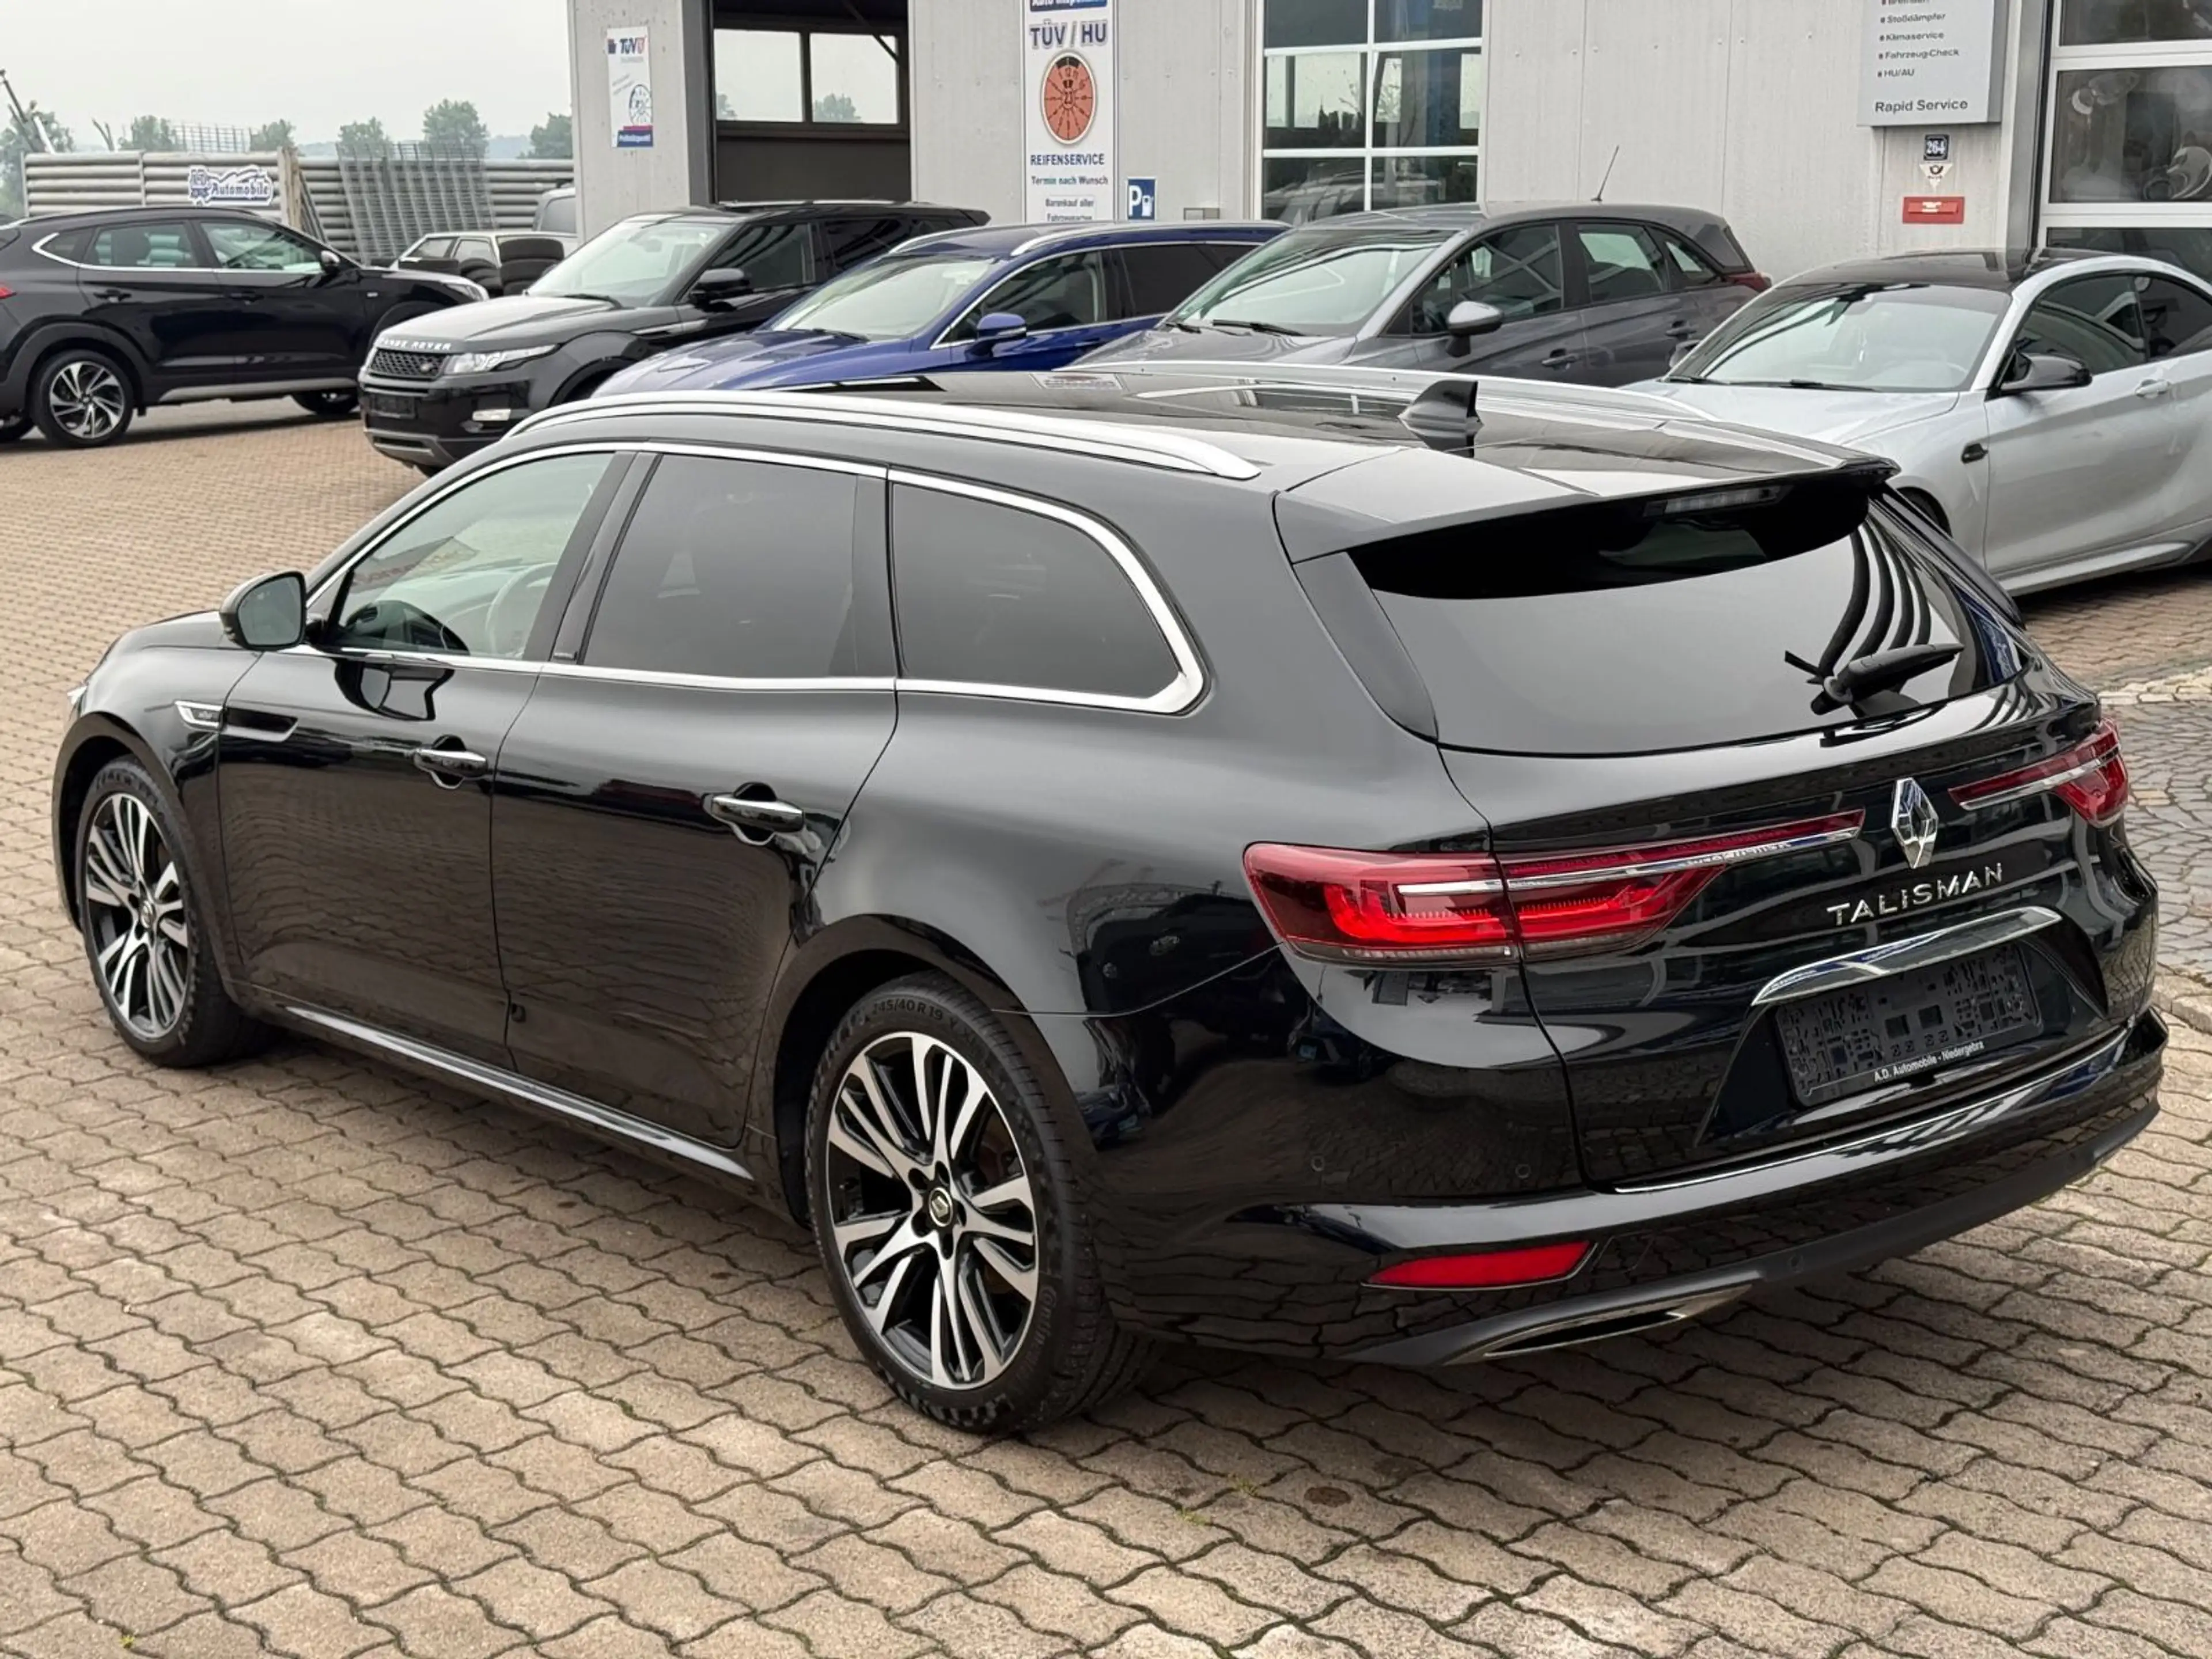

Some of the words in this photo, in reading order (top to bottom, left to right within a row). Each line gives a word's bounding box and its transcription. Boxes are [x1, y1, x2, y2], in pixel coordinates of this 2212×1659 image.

[1029, 20, 1067, 48] TÜV
[1081, 21, 1108, 46] HU
[1885, 32, 1945, 41] Klimaservice
[1884, 69, 1915, 77] HU/AU
[1875, 100, 1914, 115] Rapid
[1916, 99, 1968, 111] Service
[1030, 153, 1105, 165] REIFENSERVICE
[212, 177, 269, 195] Automobile
[1031, 176, 1057, 185] Termin
[1059, 176, 1077, 185] nach
[1078, 175, 1108, 185] Wunsch
[1128, 185, 1143, 217] P
[1826, 862, 2002, 926] TALISMAN
[1874, 1067, 1892, 1082] A.D.
[1892, 1054, 1938, 1077] Automobile
[1941, 1040, 1985, 1062] Niedergebra
